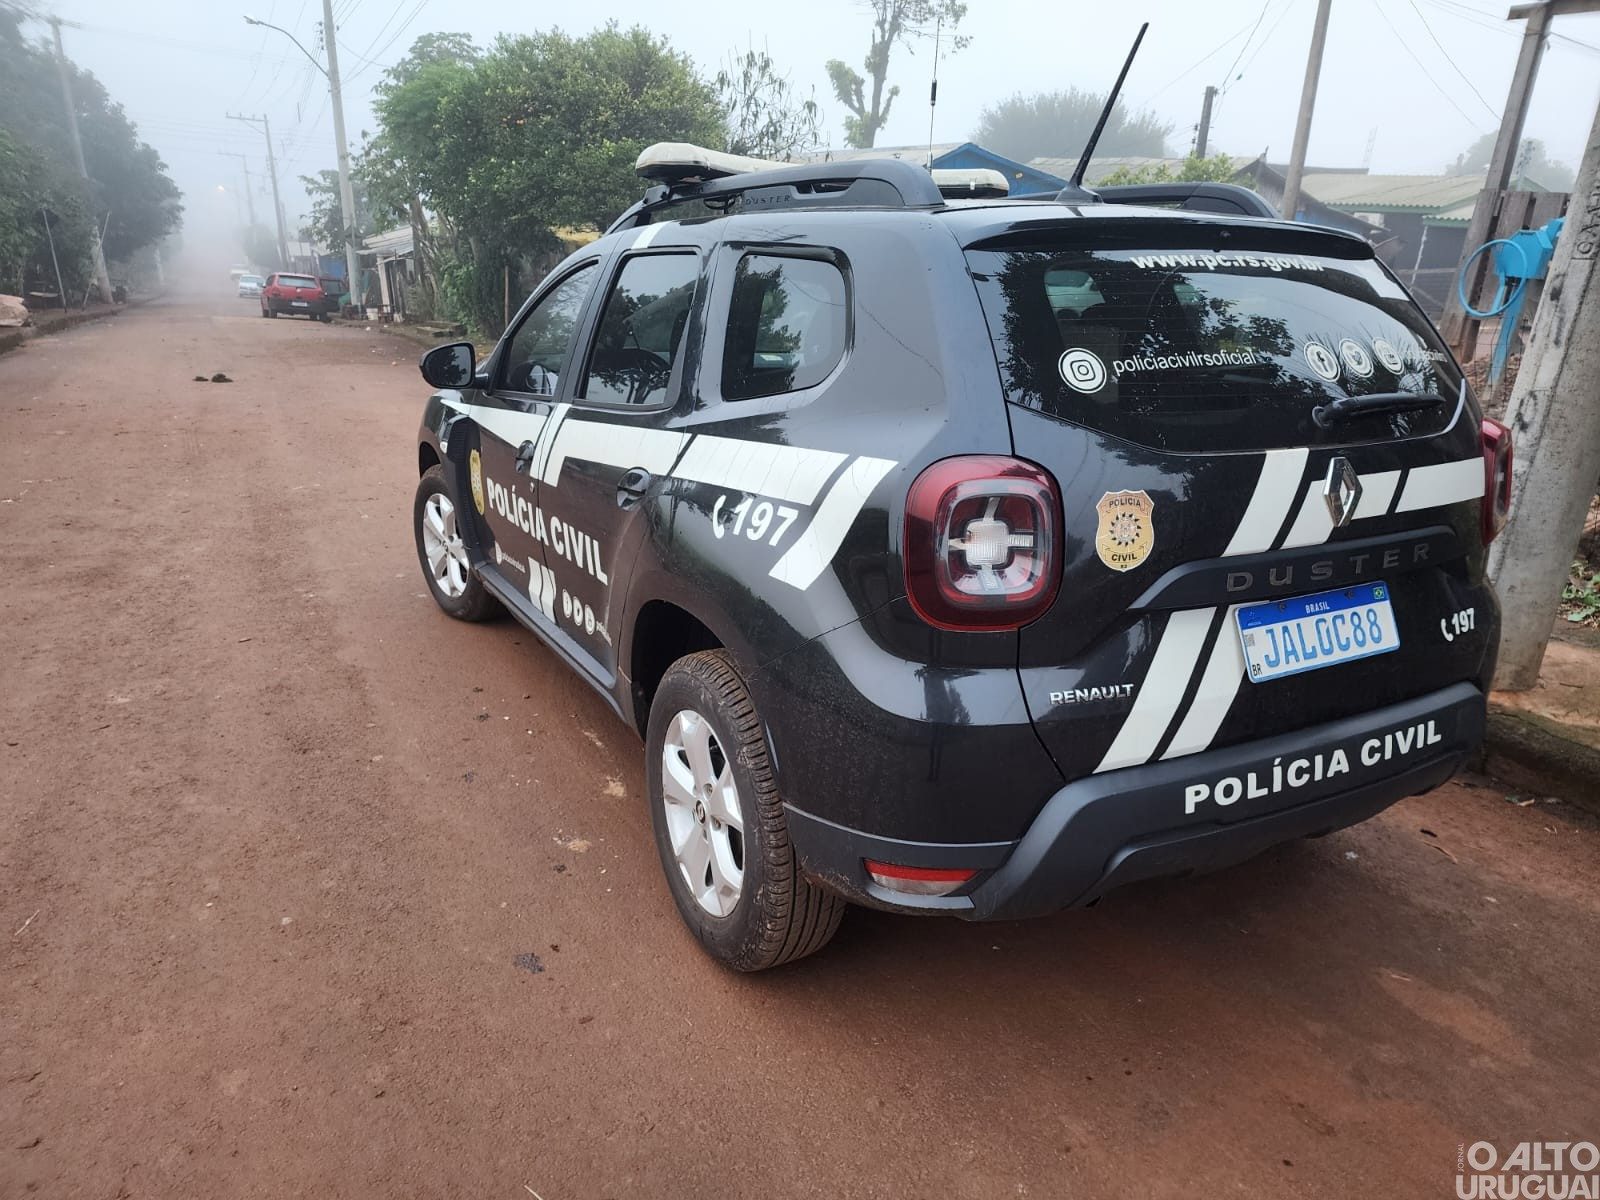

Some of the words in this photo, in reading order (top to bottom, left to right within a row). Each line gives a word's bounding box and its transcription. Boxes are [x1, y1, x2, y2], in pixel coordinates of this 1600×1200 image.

[745, 194, 791, 206] DUSTER
[1129, 254, 1325, 272] www.pc.rs.gov.br
[1113, 349, 1257, 376] policiacivilrsoficial
[486, 477, 549, 547] POLÍCIA
[550, 515, 609, 586] CIVIL
[732, 497, 799, 547] 197
[1111, 553, 1138, 562] CIVIL
[1226, 543, 1430, 593] DUSTER
[1305, 601, 1330, 614] BRASIL
[1451, 607, 1475, 635] 197
[1252, 664, 1262, 676] BR
[1049, 683, 1134, 706] RENAULT
[1184, 749, 1351, 815] POLÍCIA
[1360, 720, 1442, 767] CIVIL
